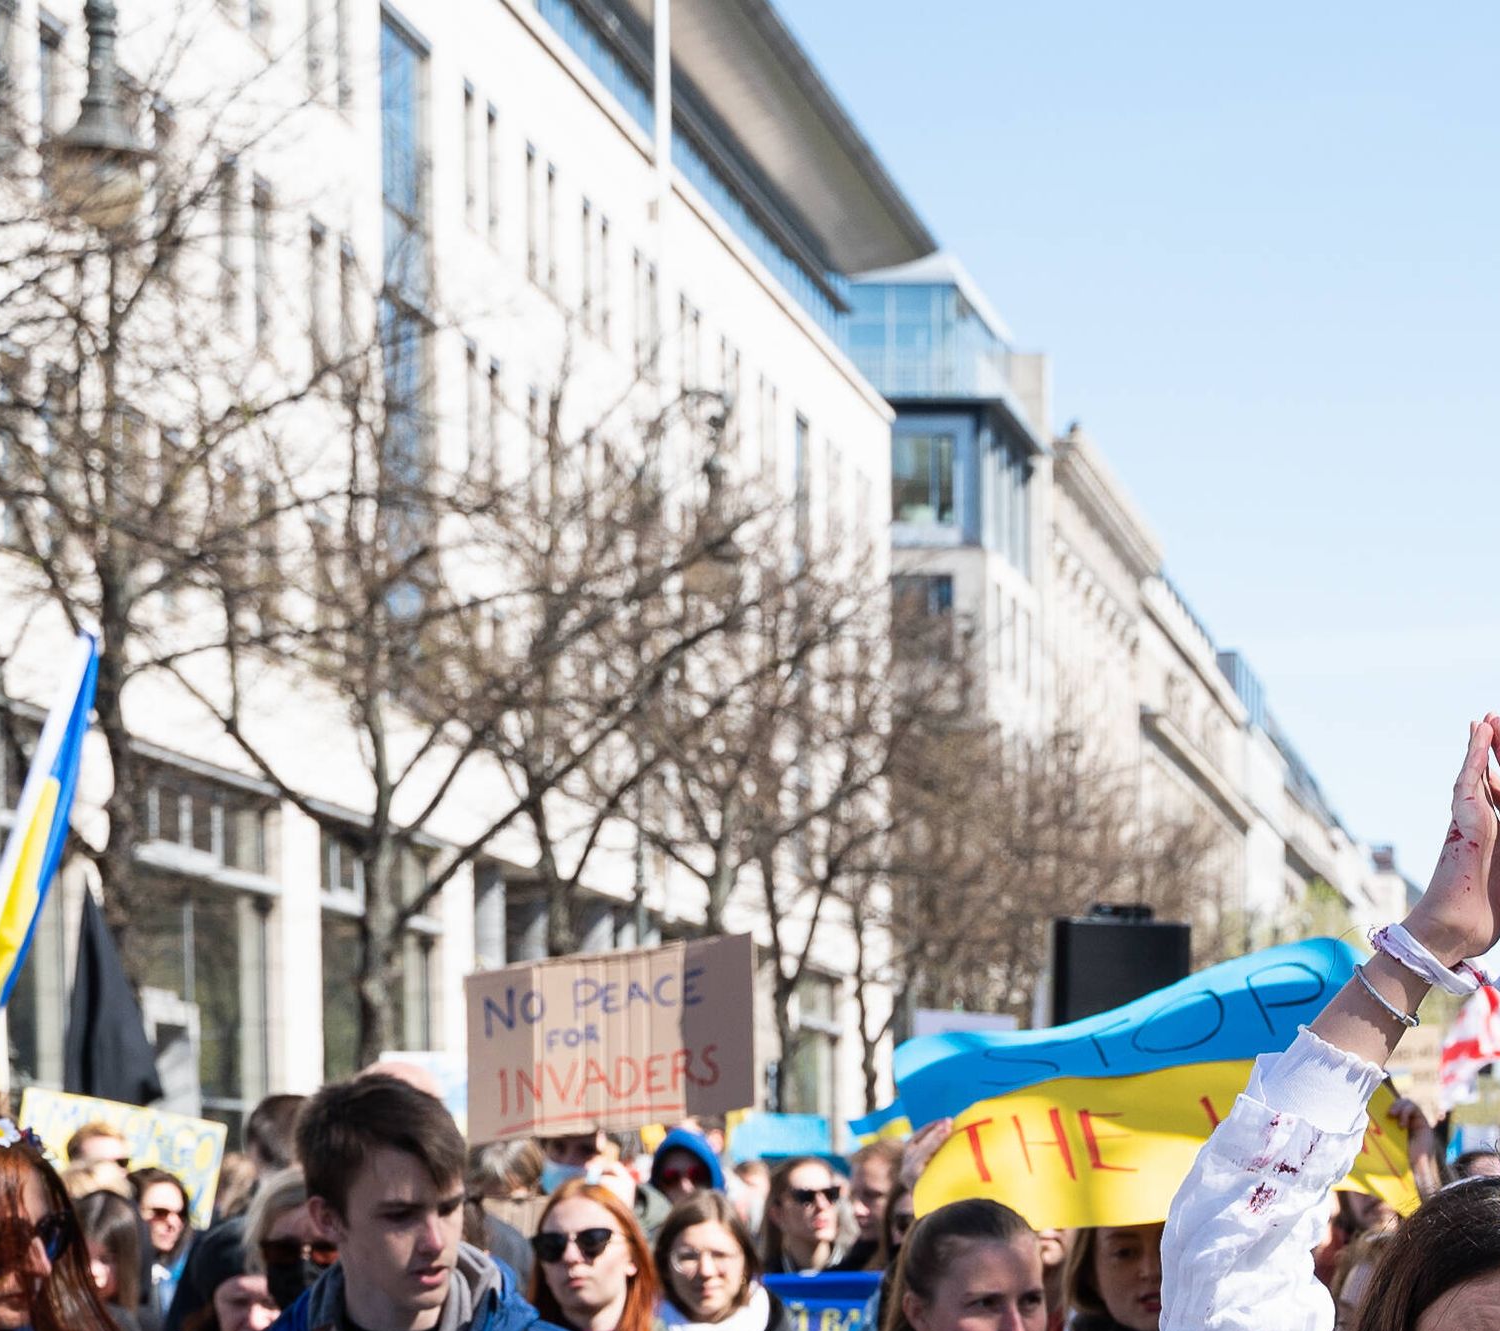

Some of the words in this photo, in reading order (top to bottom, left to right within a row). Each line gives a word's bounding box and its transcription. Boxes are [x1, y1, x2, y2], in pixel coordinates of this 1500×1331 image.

[482, 984, 547, 1039] NO
[571, 966, 707, 1020] PEACE
[546, 1023, 600, 1052] FOR
[980, 961, 1326, 1086] STOP
[496, 1043, 721, 1116] INVADERS
[960, 1107, 1138, 1182] THE
